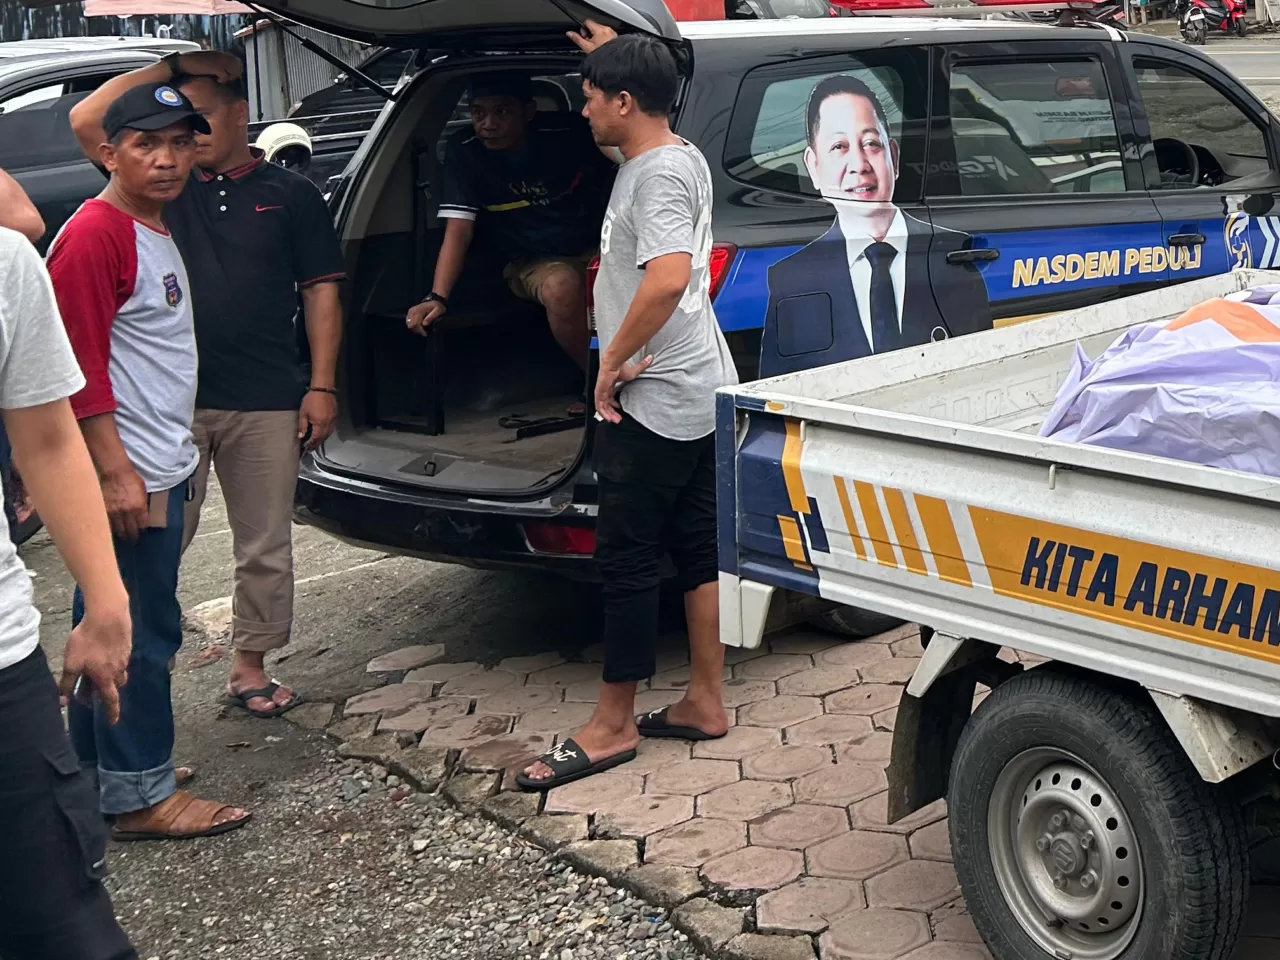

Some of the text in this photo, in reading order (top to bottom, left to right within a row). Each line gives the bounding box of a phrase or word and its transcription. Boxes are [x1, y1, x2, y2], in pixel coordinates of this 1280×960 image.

[1012, 244, 1202, 288] NASDEM PEDULI
[1020, 536, 1118, 608] KITA
